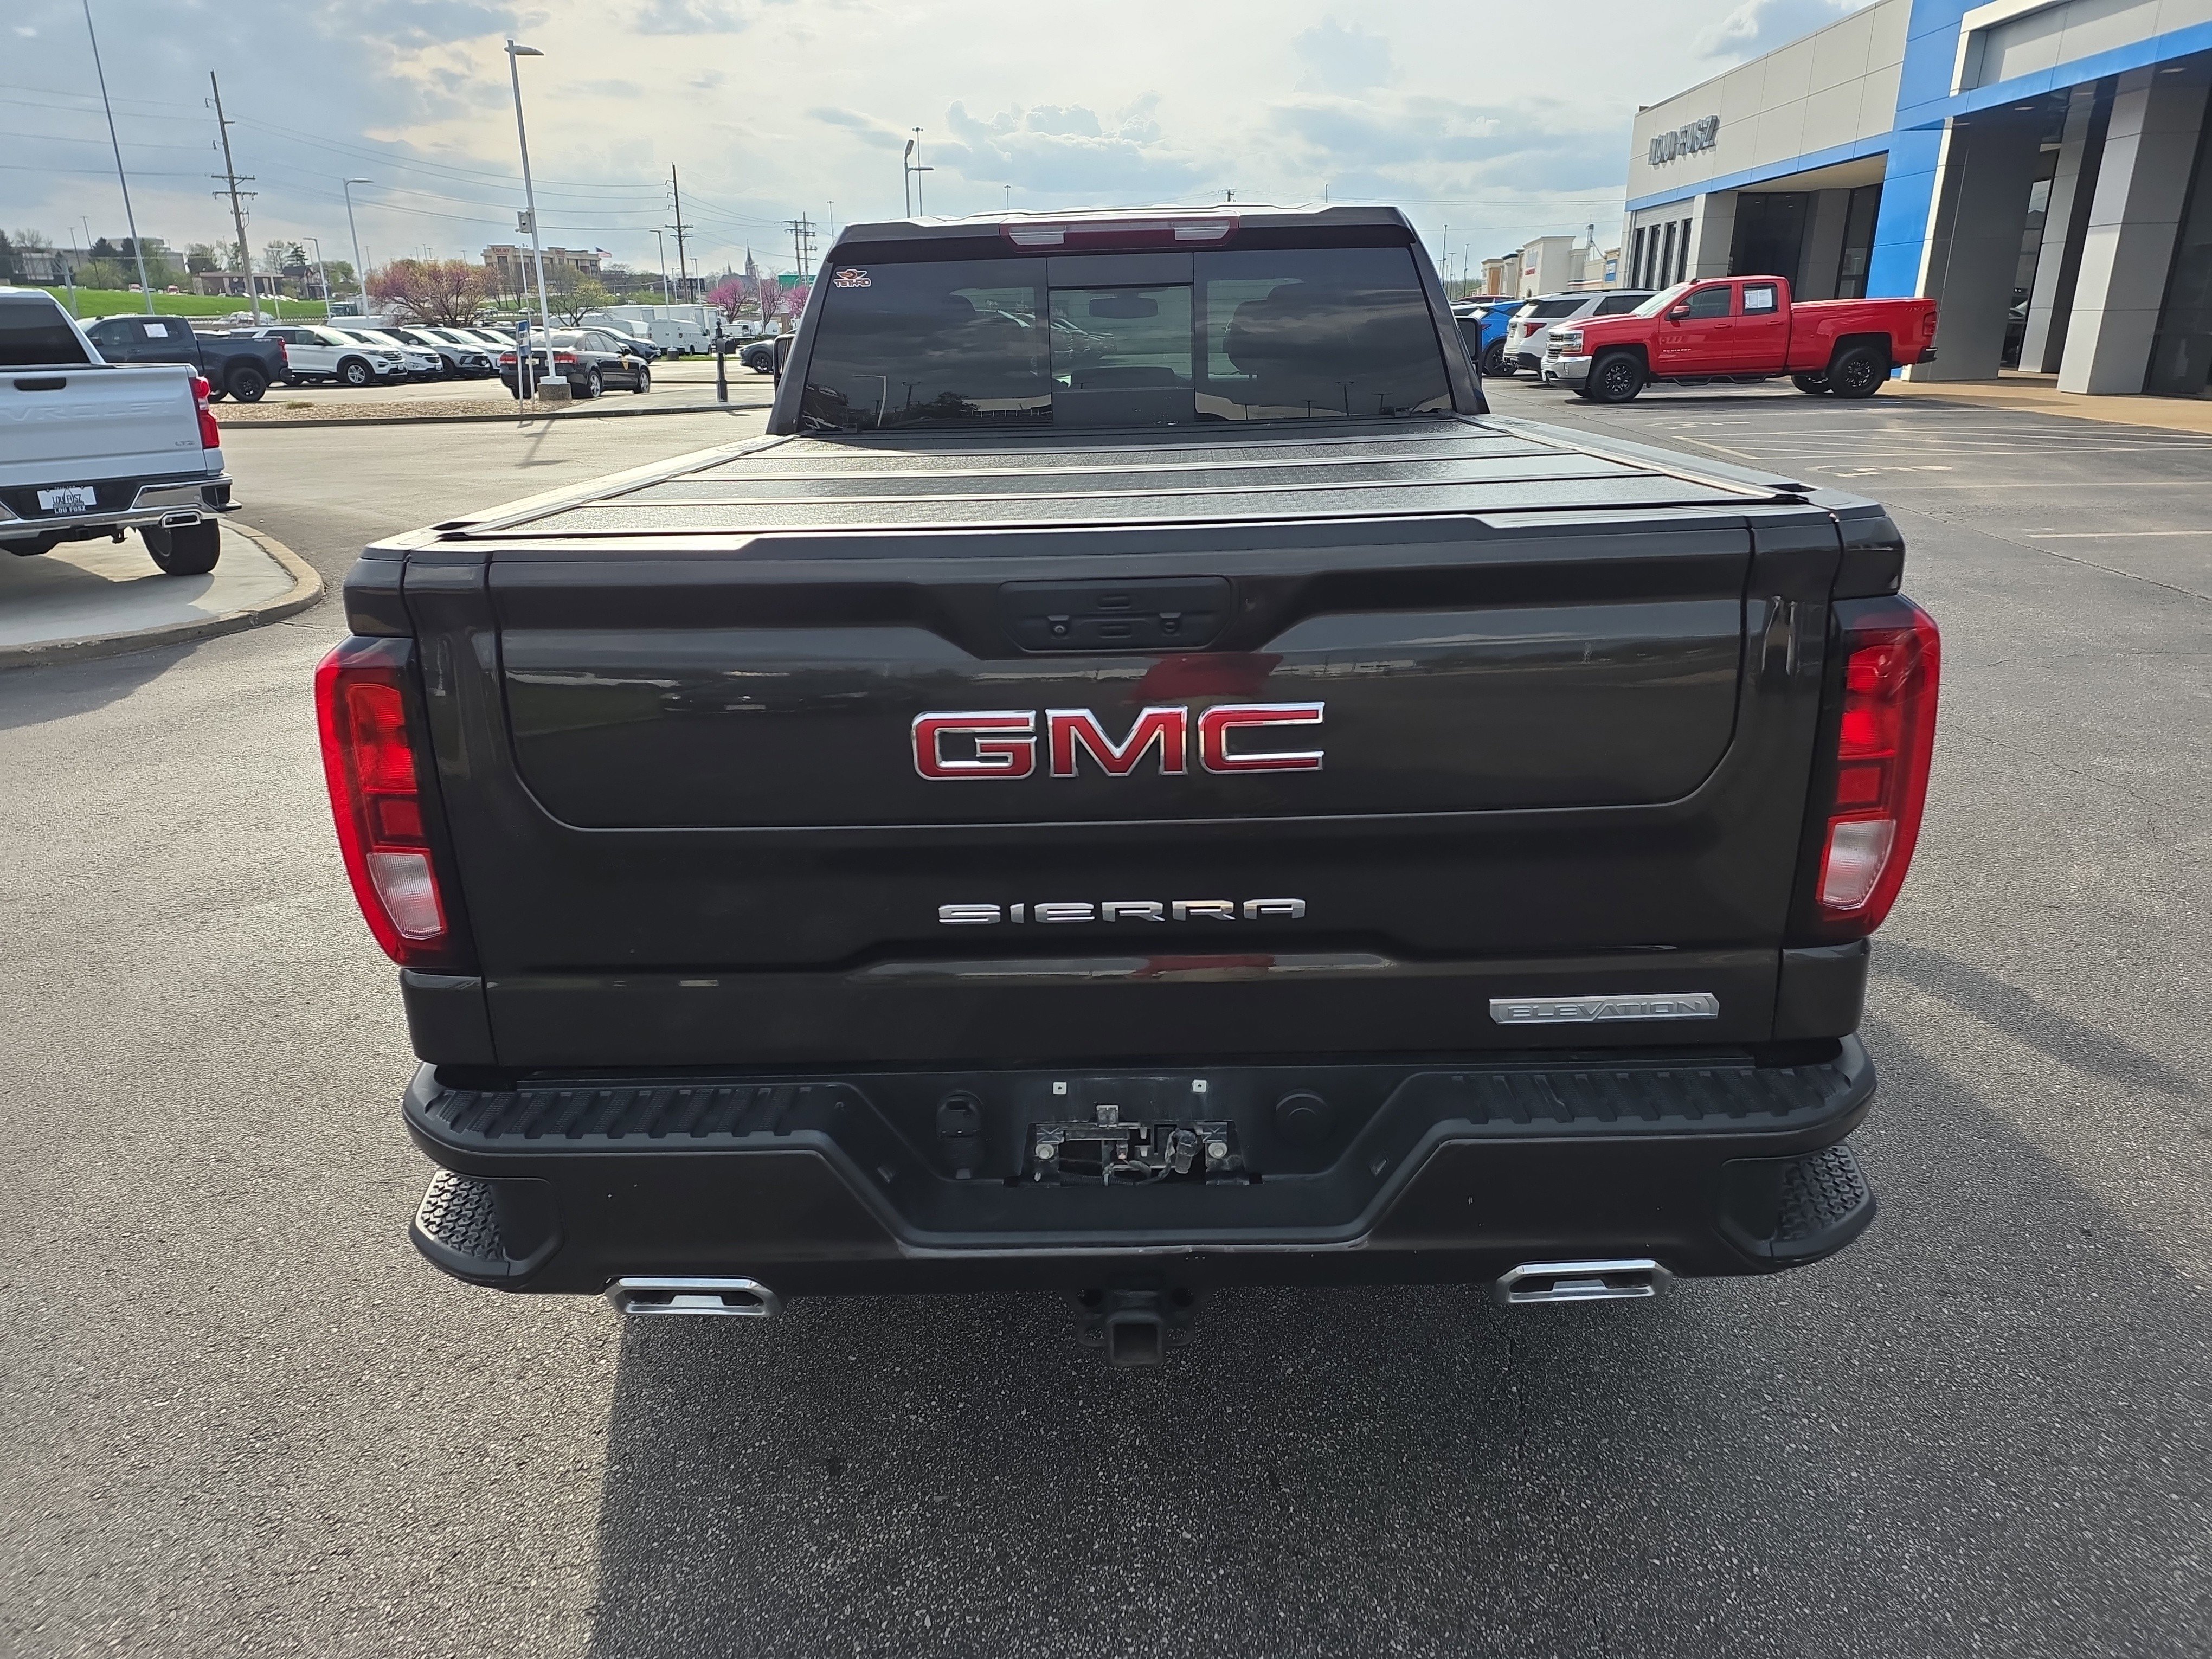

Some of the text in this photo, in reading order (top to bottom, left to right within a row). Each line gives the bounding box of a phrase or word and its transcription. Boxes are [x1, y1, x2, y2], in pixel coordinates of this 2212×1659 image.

[1648, 115, 1720, 165] LOU FUSZ
[52, 494, 81, 504] LOU FUSZ
[911, 701, 1326, 781] GMC
[938, 898, 1307, 924] SIERRA
[1508, 1001, 1702, 1017] ELEVATION
